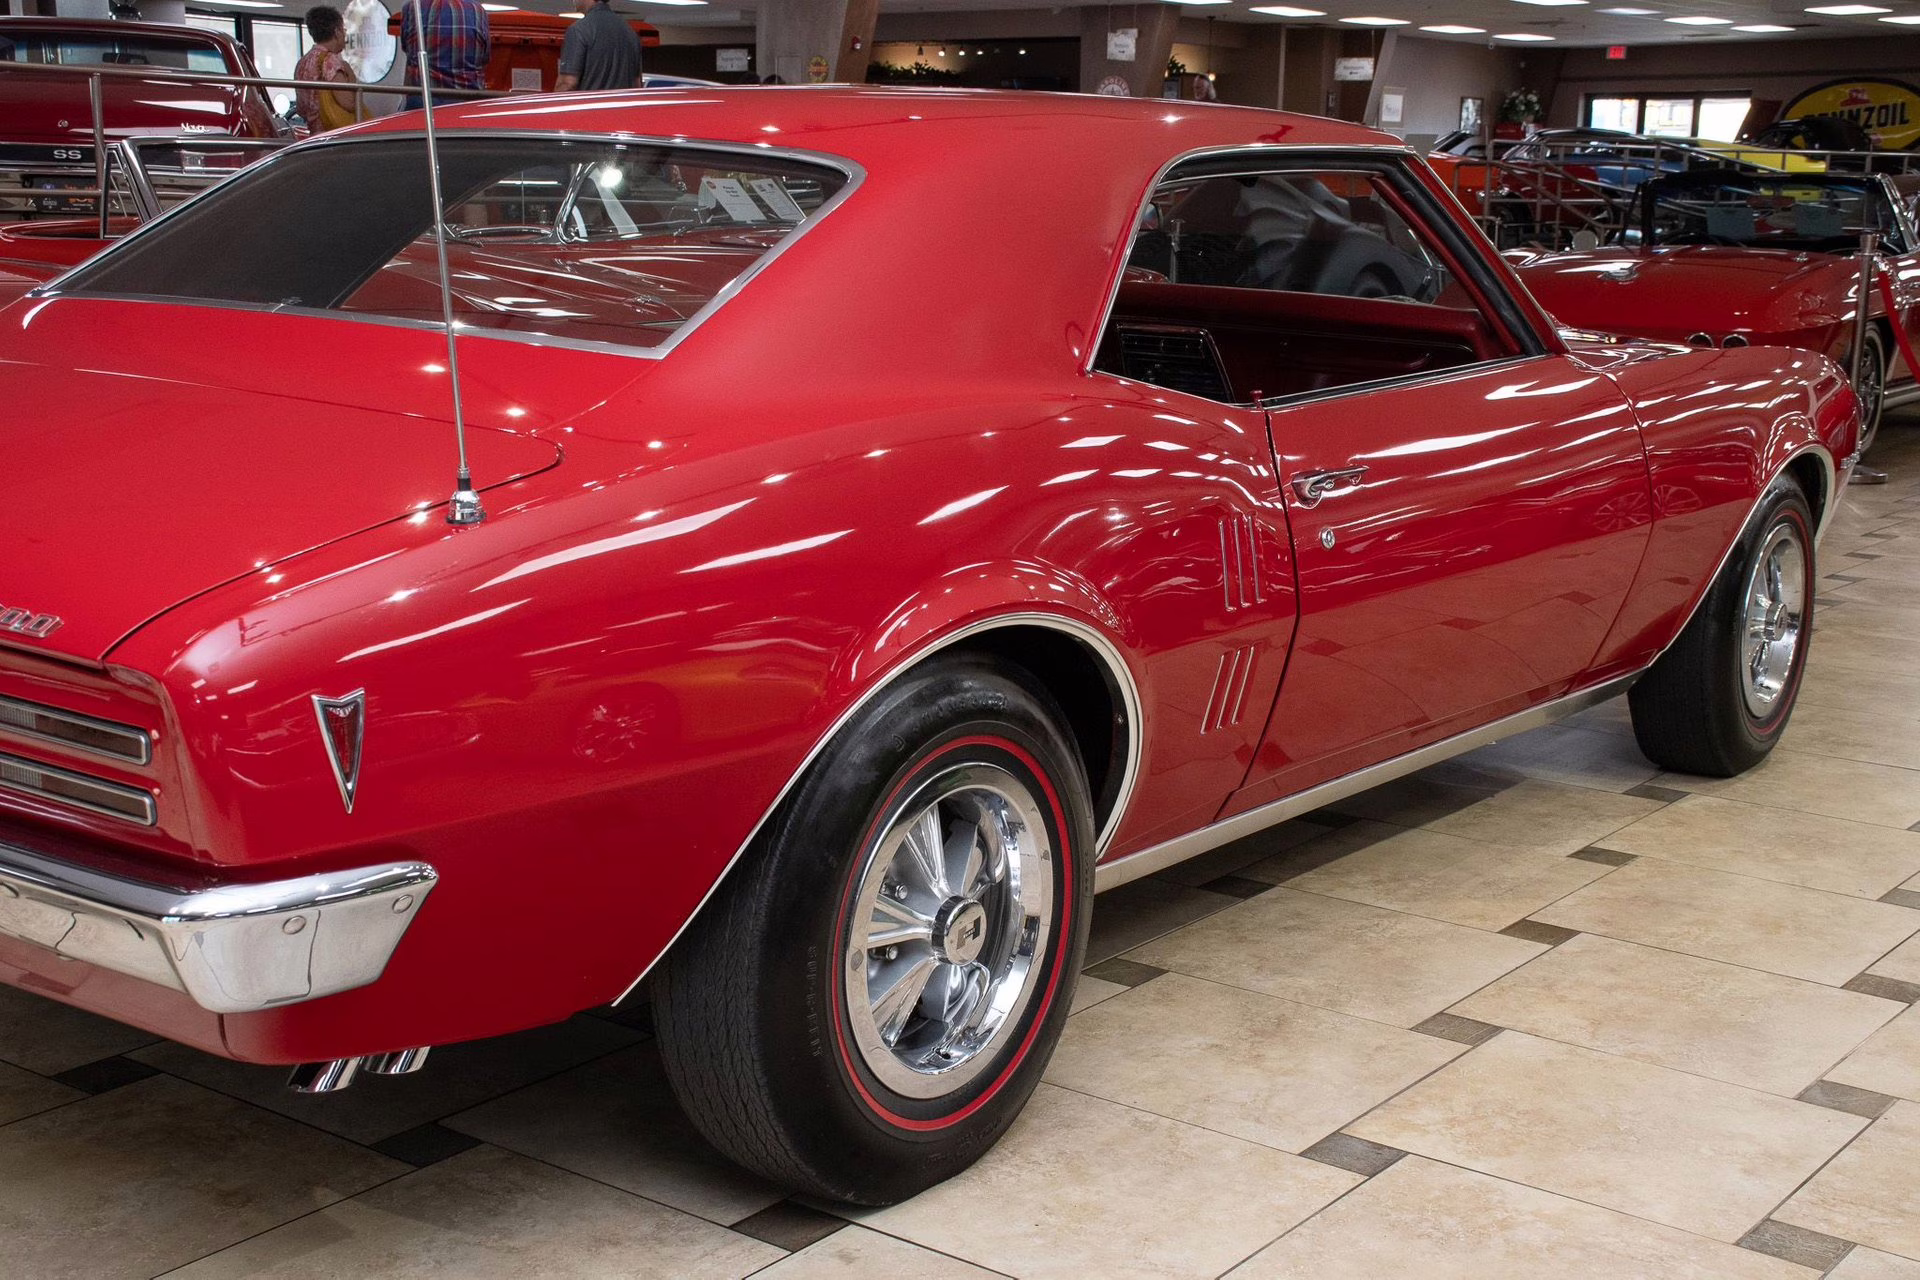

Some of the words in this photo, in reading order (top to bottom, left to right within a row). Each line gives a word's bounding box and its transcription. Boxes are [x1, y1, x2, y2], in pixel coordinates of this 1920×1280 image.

[1803, 101, 1909, 129] NZOIL
[181, 122, 210, 133] Nova
[53, 149, 82, 160] SS
